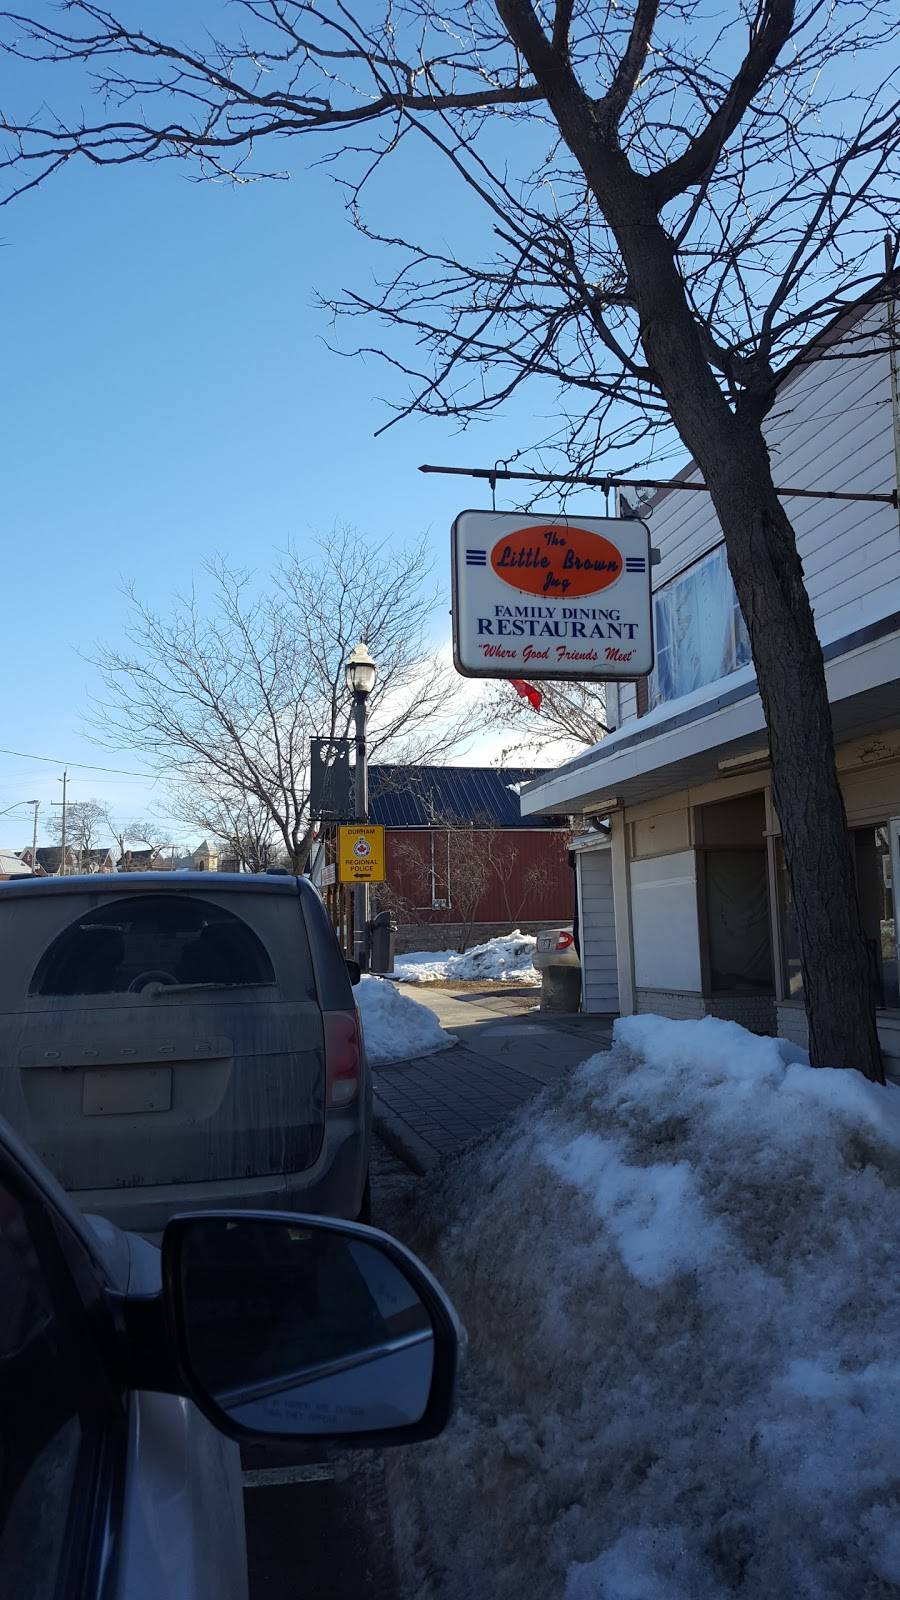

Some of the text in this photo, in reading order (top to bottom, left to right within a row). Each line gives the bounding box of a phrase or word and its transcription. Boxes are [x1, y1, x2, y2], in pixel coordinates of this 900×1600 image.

[544, 531, 566, 546] The
[497, 547, 618, 572] Little Brown
[543, 572, 571, 592] Jug
[494, 605, 620, 621] FAMILY DINING
[477, 618, 639, 640] RESTAURANT
[522, 644, 550, 663] Good
[556, 646, 598, 662] Friends
